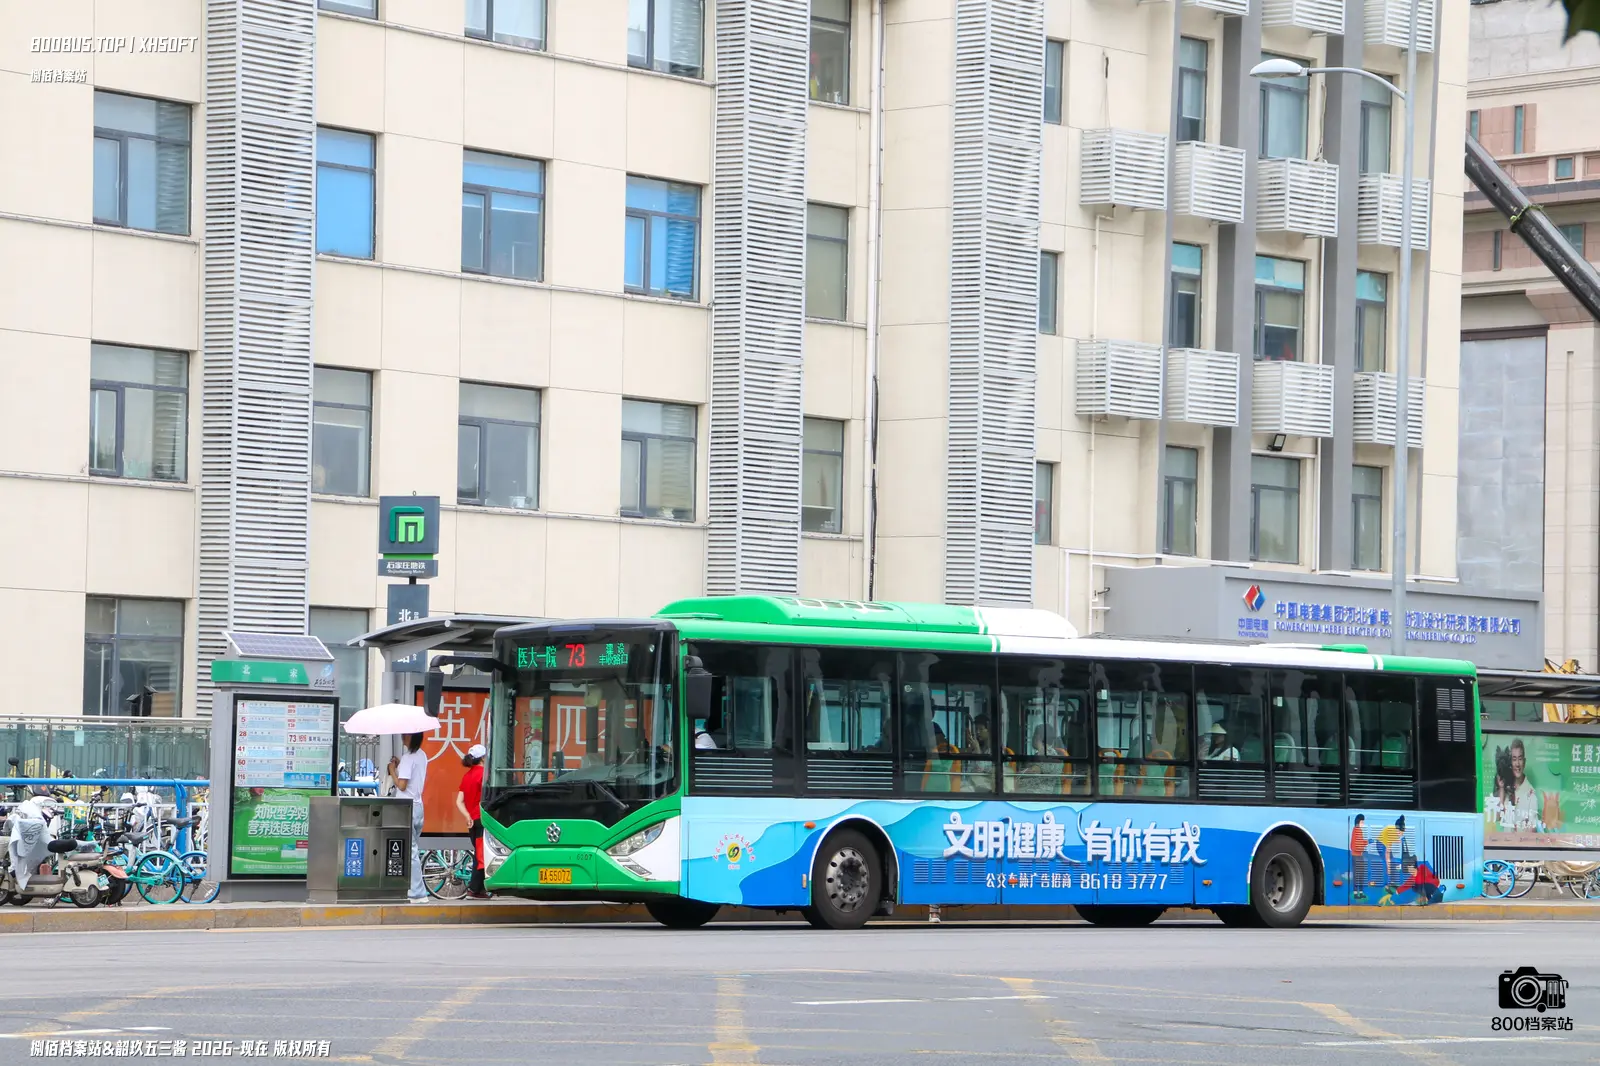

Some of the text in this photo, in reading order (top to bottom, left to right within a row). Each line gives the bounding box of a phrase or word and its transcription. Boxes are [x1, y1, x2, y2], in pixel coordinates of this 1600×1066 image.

[386, 561, 426, 570] 石家庄地铁
[1274, 601, 1521, 635] 中国电建集团河北省电测设计研究院有限公司
[1274, 621, 1322, 633] POWERCHINA
[1323, 626, 1344, 635] HEBEI
[1345, 627, 1377, 638] ELECTRIC
[518, 646, 557, 668] 医大一院
[565, 643, 585, 667] 73
[289, 735, 296, 743] 73
[943, 812, 1206, 864] 文明健康 有你有我
[1080, 873, 1122, 890] 8618
[1127, 873, 1168, 890] 3777
